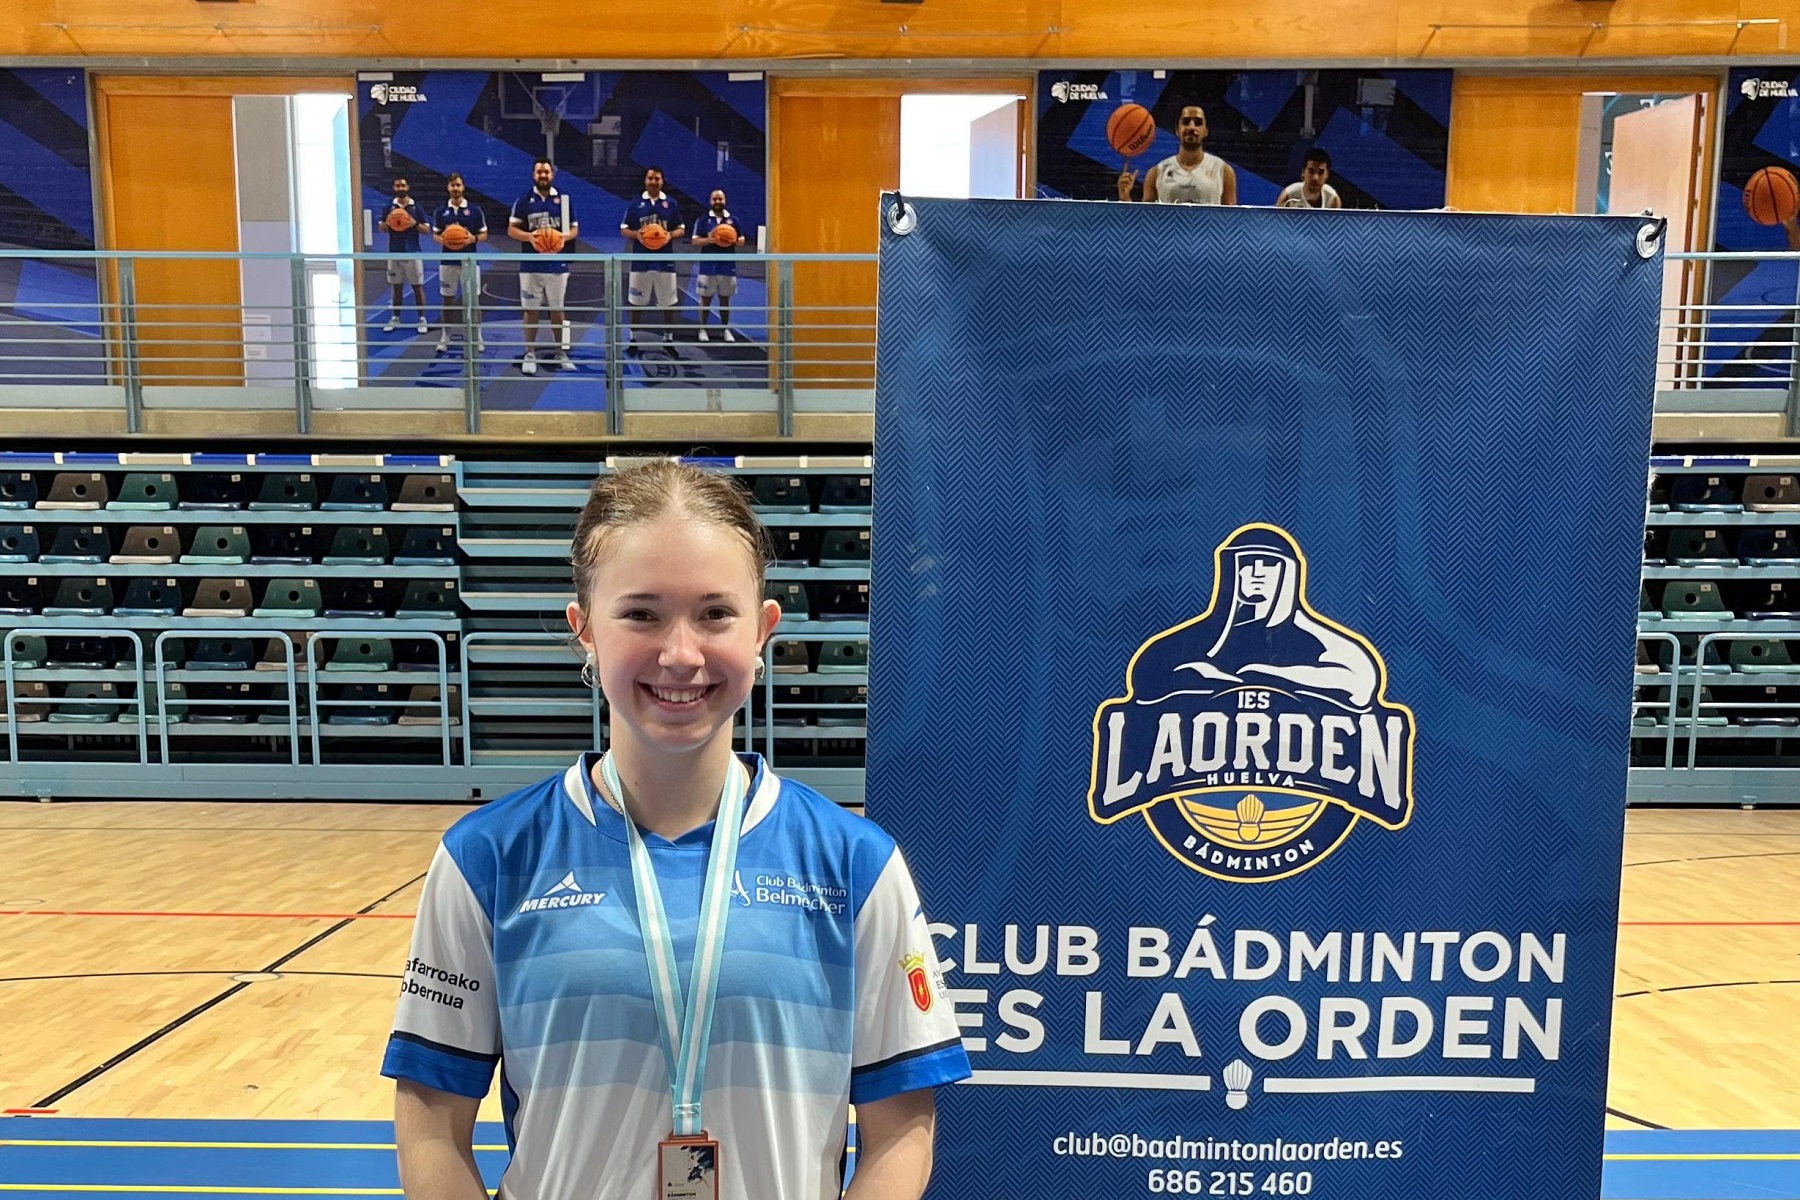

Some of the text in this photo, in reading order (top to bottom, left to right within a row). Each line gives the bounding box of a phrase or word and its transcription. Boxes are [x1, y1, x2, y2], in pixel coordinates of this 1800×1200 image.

[1238, 690, 1270, 709] IES
[1205, 772, 1296, 787] HUELVA
[1183, 835, 1315, 872] BÁDMINTON
[756, 875, 785, 887] Club
[519, 892, 606, 914] MERCURY
[926, 913, 1567, 984] CLUB BÁDMINTON
[405, 957, 481, 992] afarroako
[400, 978, 465, 1010] obernua
[947, 988, 1564, 1061] ES LA ORDEN
[1052, 1131, 1403, 1162] club@badmintonlaorden.es
[1147, 1169, 1313, 1197] 686 215 460
